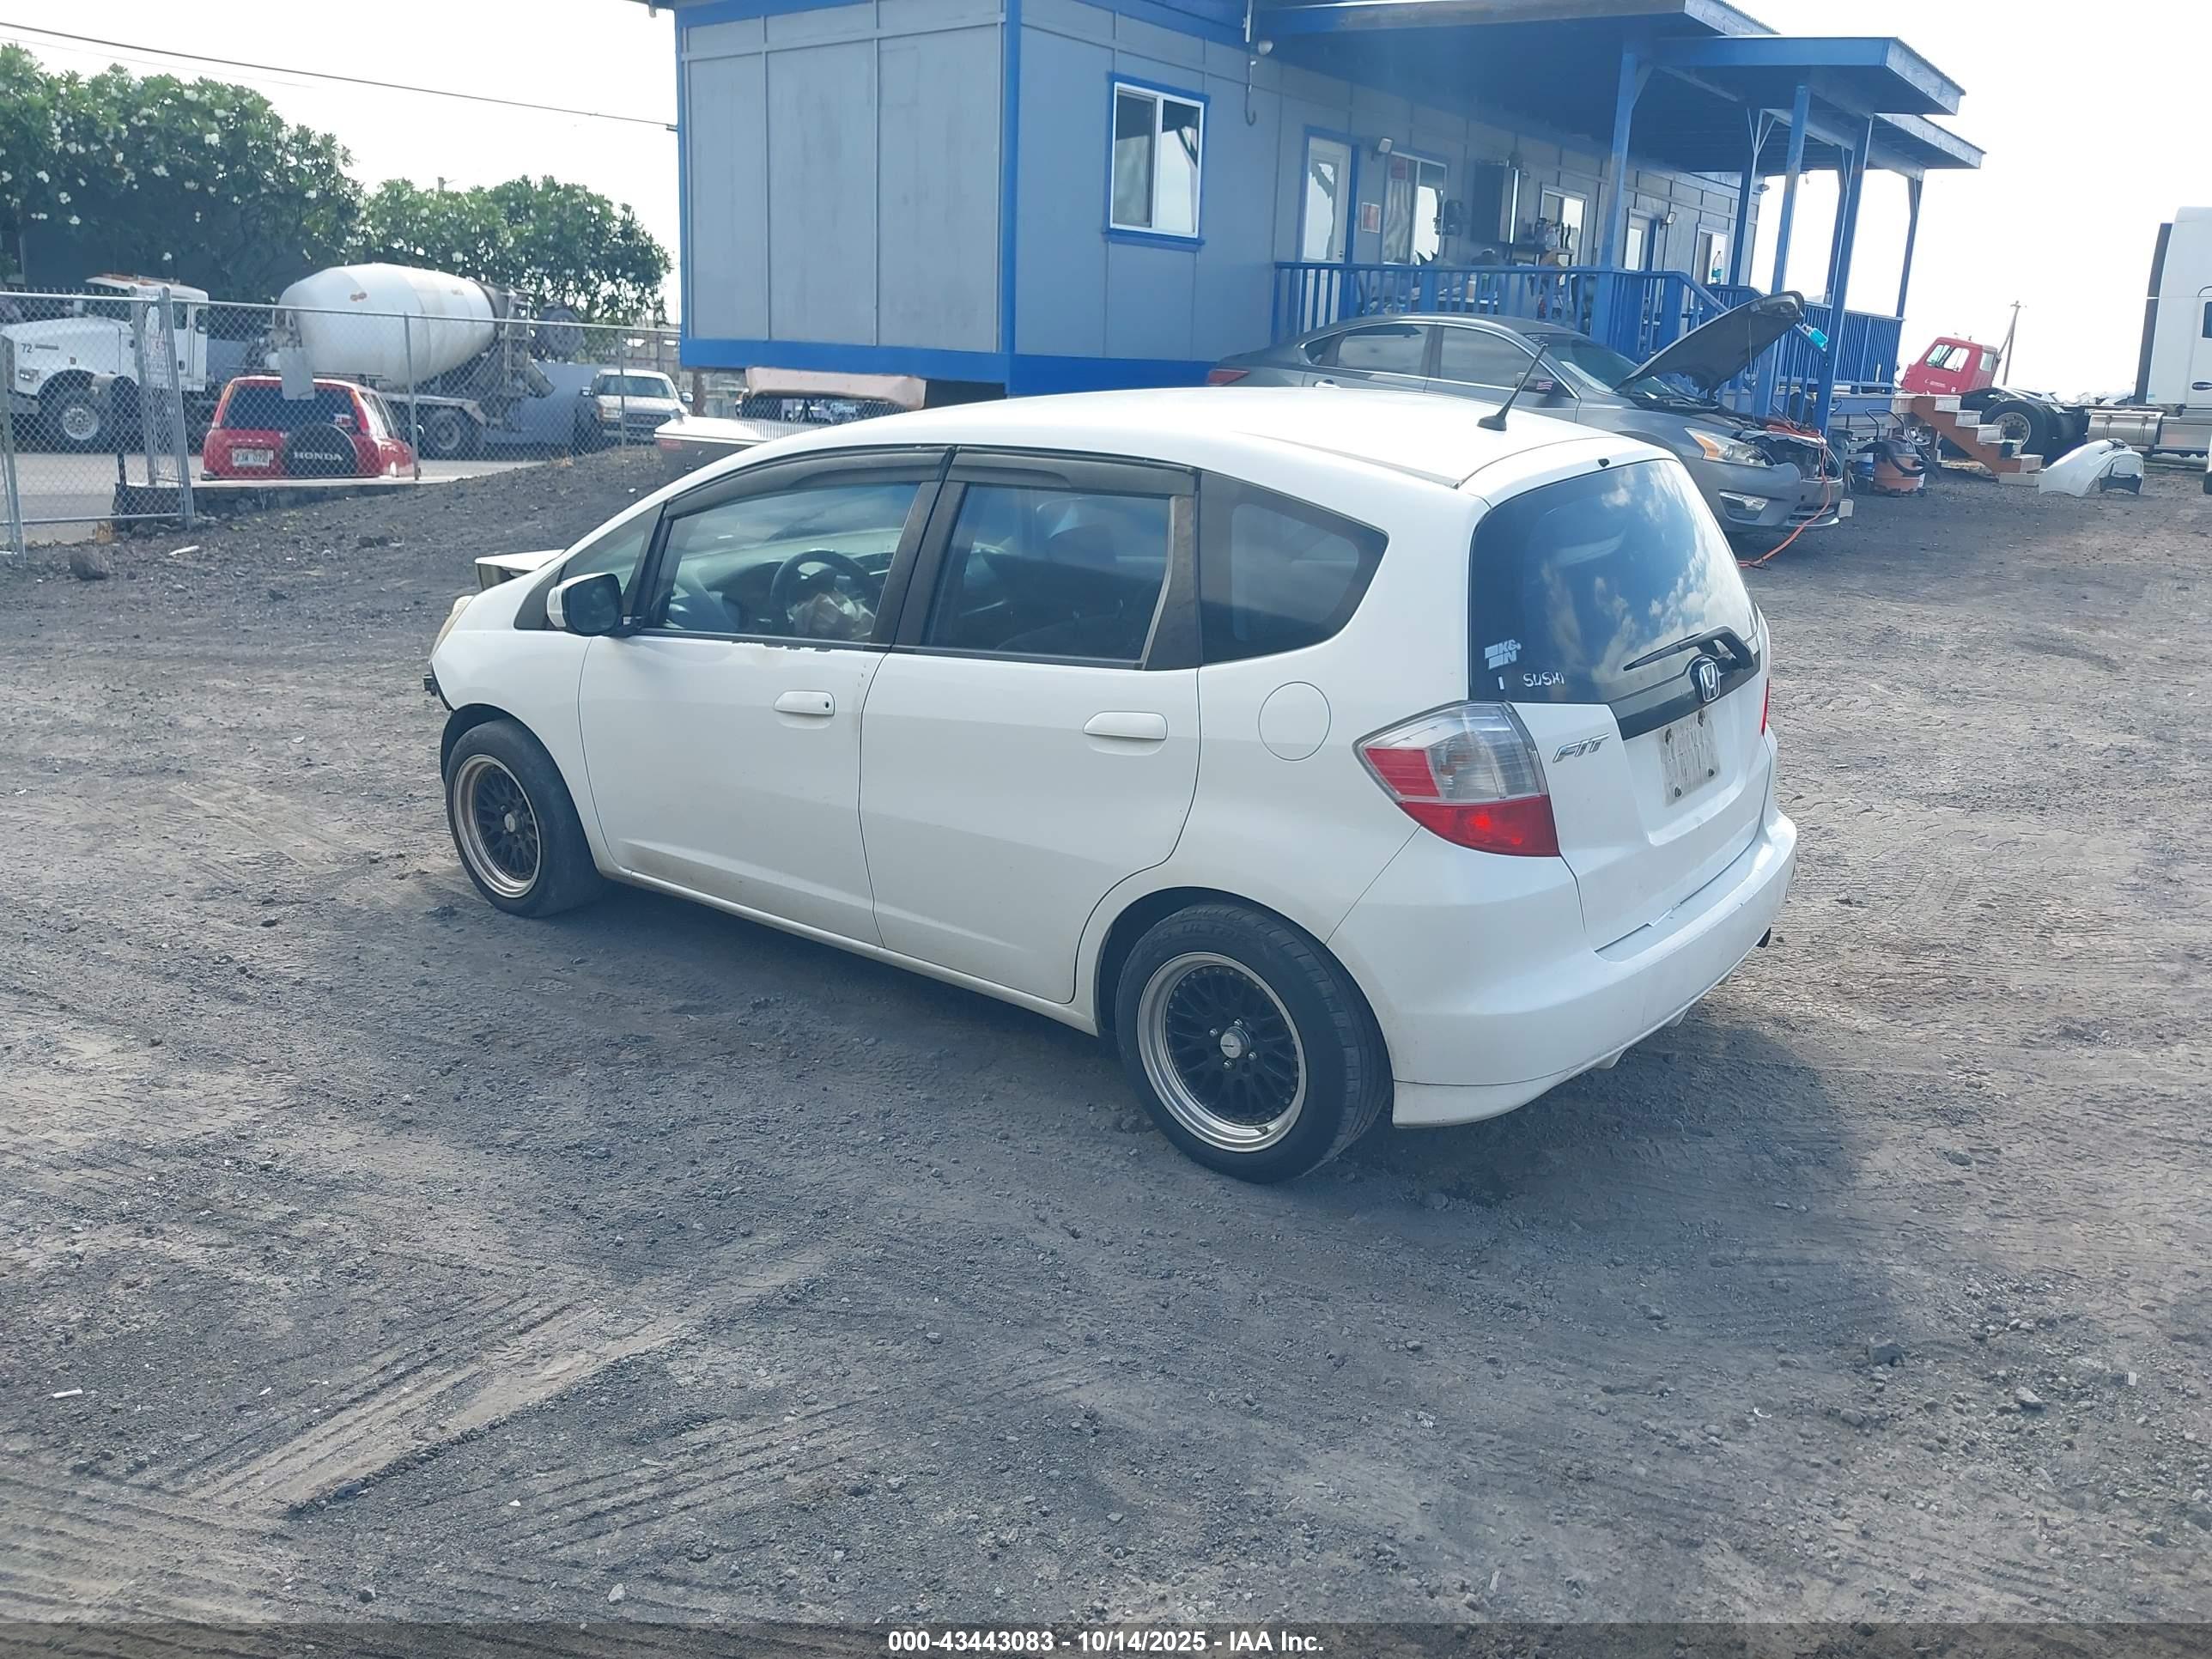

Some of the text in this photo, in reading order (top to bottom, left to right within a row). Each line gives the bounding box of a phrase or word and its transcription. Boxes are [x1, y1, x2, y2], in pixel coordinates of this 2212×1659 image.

[21, 343, 33, 354] 72
[293, 451, 343, 461] HONDA
[1552, 732, 1610, 763] FIT
